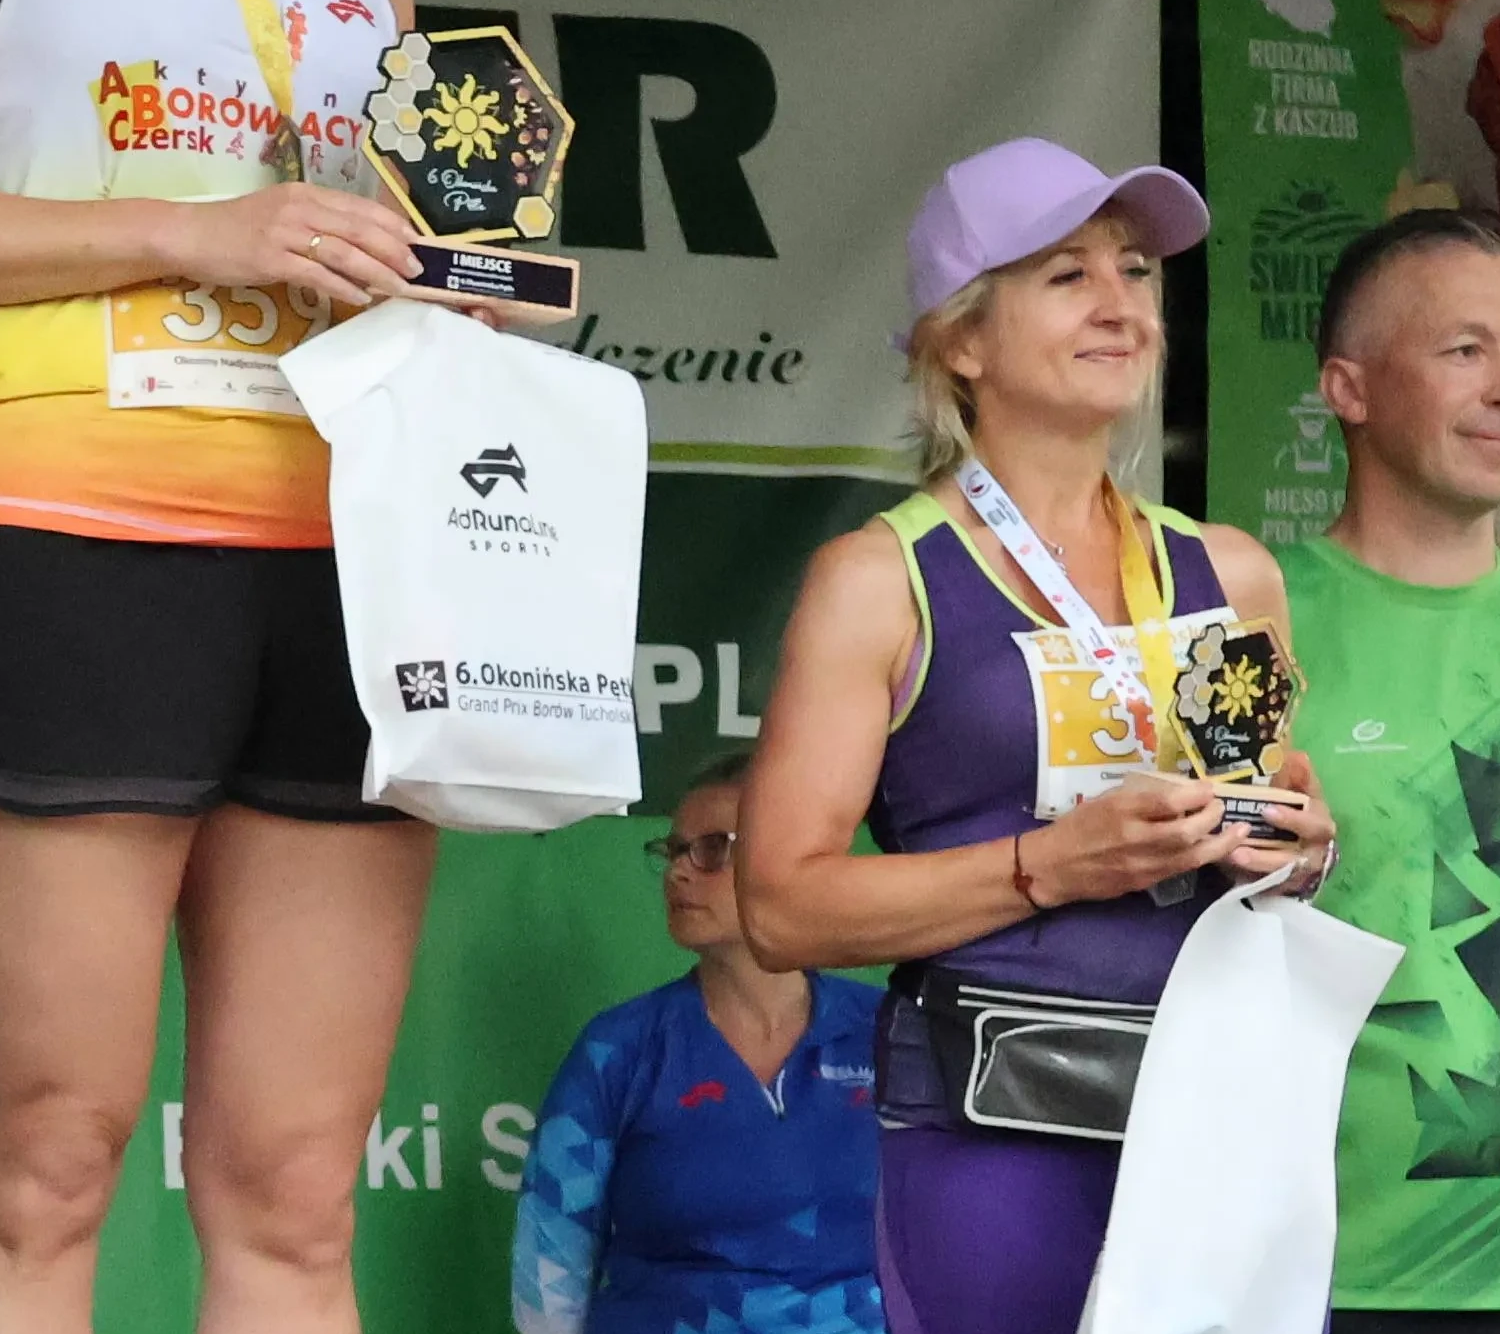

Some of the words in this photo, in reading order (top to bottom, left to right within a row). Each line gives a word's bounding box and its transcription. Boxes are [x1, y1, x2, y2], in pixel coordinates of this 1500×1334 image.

[109, 110, 214, 155] Czersk
[457, 694, 499, 714] Grand
[503, 697, 528, 716] Prix
